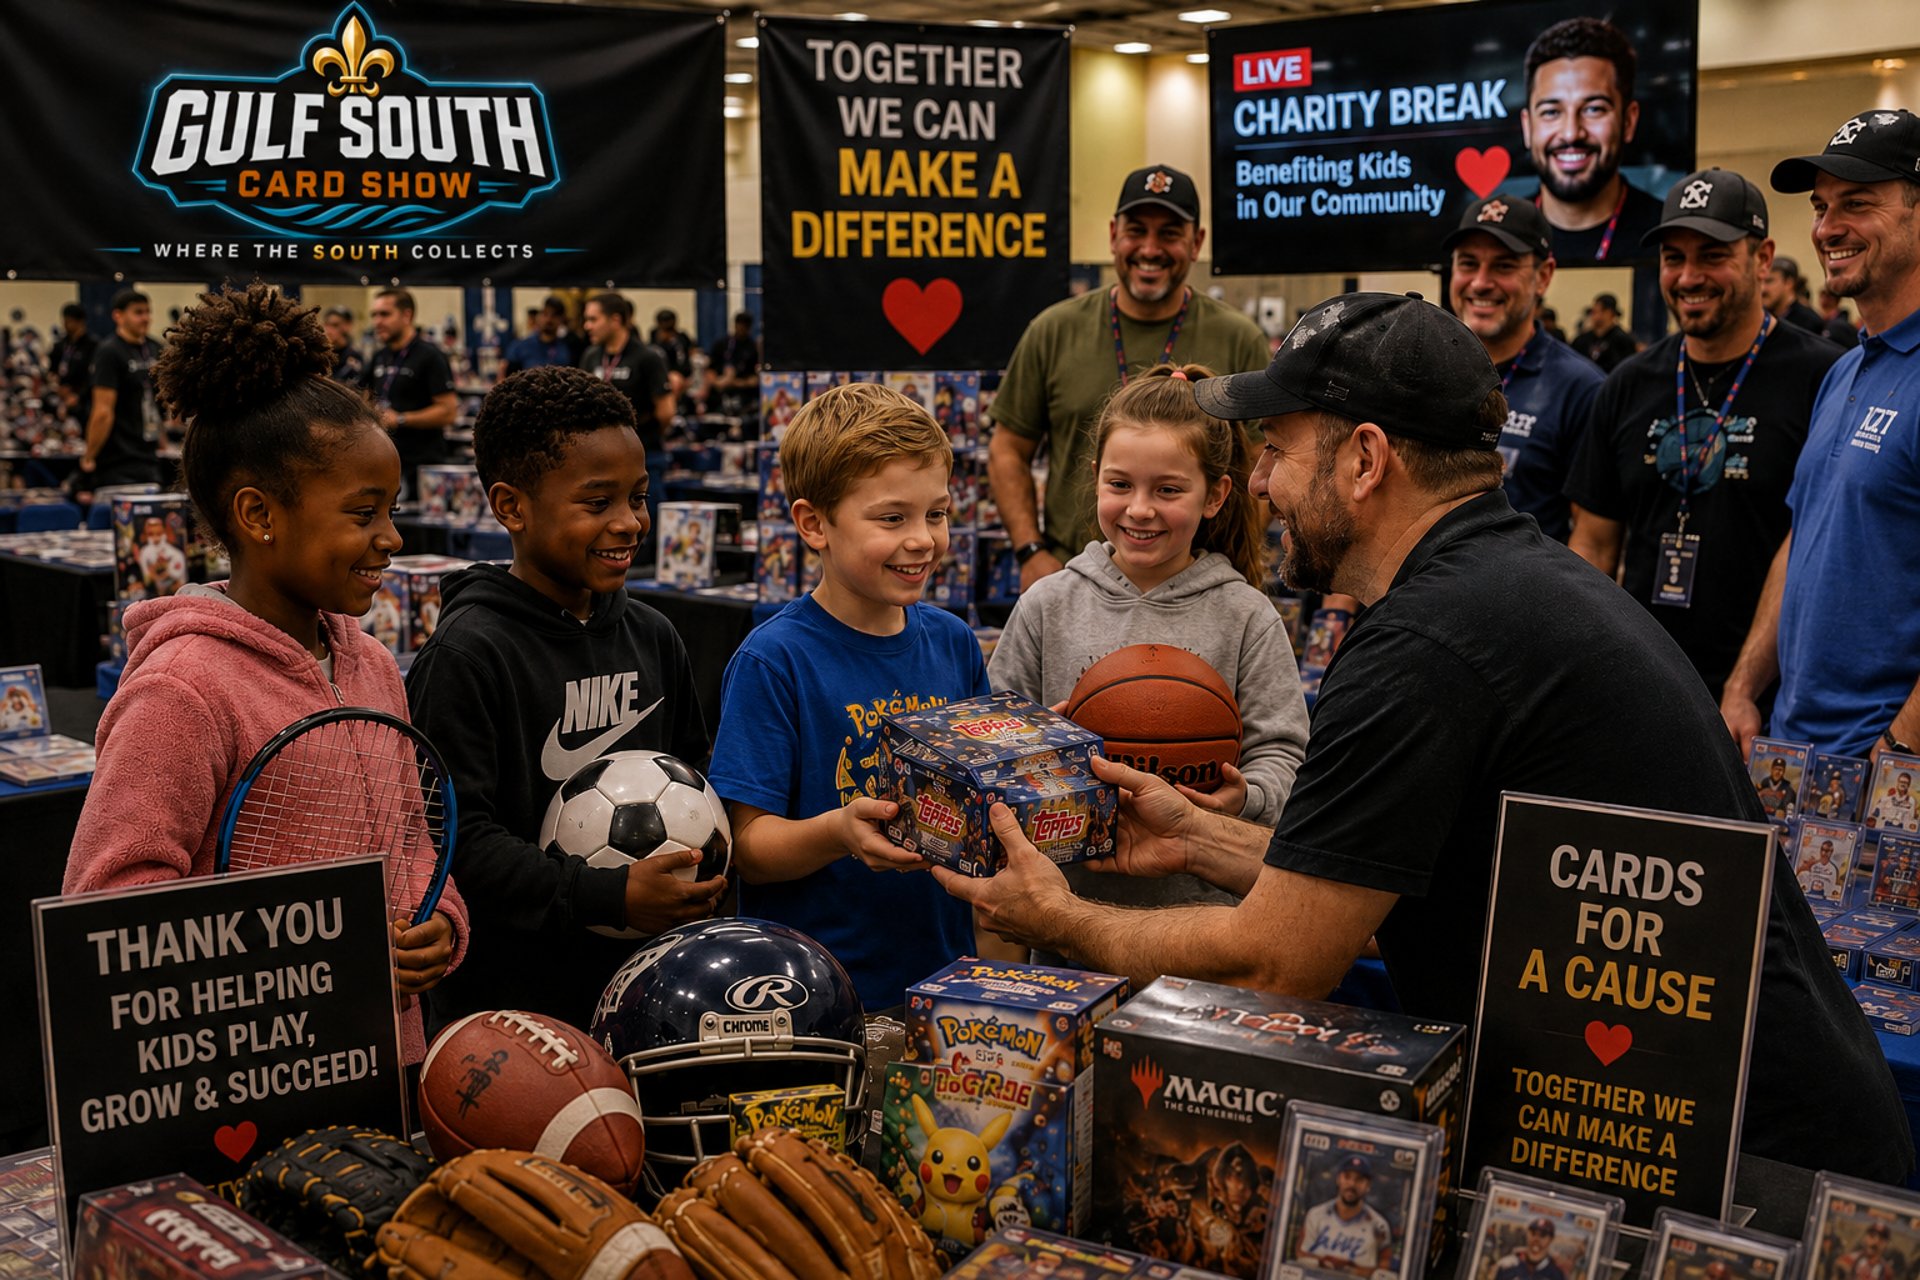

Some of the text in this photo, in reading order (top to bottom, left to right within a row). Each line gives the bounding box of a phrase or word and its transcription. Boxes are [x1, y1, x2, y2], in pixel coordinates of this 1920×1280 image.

[806, 39, 1023, 89] TOGETHER
[1242, 55, 1302, 85] LIVE
[151, 89, 546, 178] GULF SOUTH
[838, 96, 996, 141] WE CAN
[1234, 79, 1507, 137] CHARITY BREAK
[238, 170, 473, 199] CARD SHOW
[838, 147, 1022, 199] MAKE A
[1236, 150, 1411, 188] Benefiting Kids
[1237, 183, 1445, 219] in Our Community
[153, 243, 534, 260] WHERE THE SOUTH COLLECTS
[791, 210, 1047, 258] DIFFERENCE
[561, 671, 639, 734] NIKE
[1549, 843, 1706, 907] CARDS
[87, 897, 344, 976] THANK YOU
[1575, 901, 1665, 957] FOR
[111, 961, 334, 1030] FOR HELPING
[1518, 948, 1716, 1021] A CAUSE
[137, 1012, 316, 1074] KIDS PLAY,
[80, 1045, 379, 1134] GROW & SUCCEED!
[1163, 1075, 1278, 1117] MAGIC
[1164, 1100, 1184, 1112] THE
[1511, 1067, 1645, 1117] TOGETHER
[1653, 1093, 1697, 1127] WE
[1517, 1104, 1678, 1160] CAN MAKE A
[1510, 1136, 1679, 1197] DIFFERENCE
